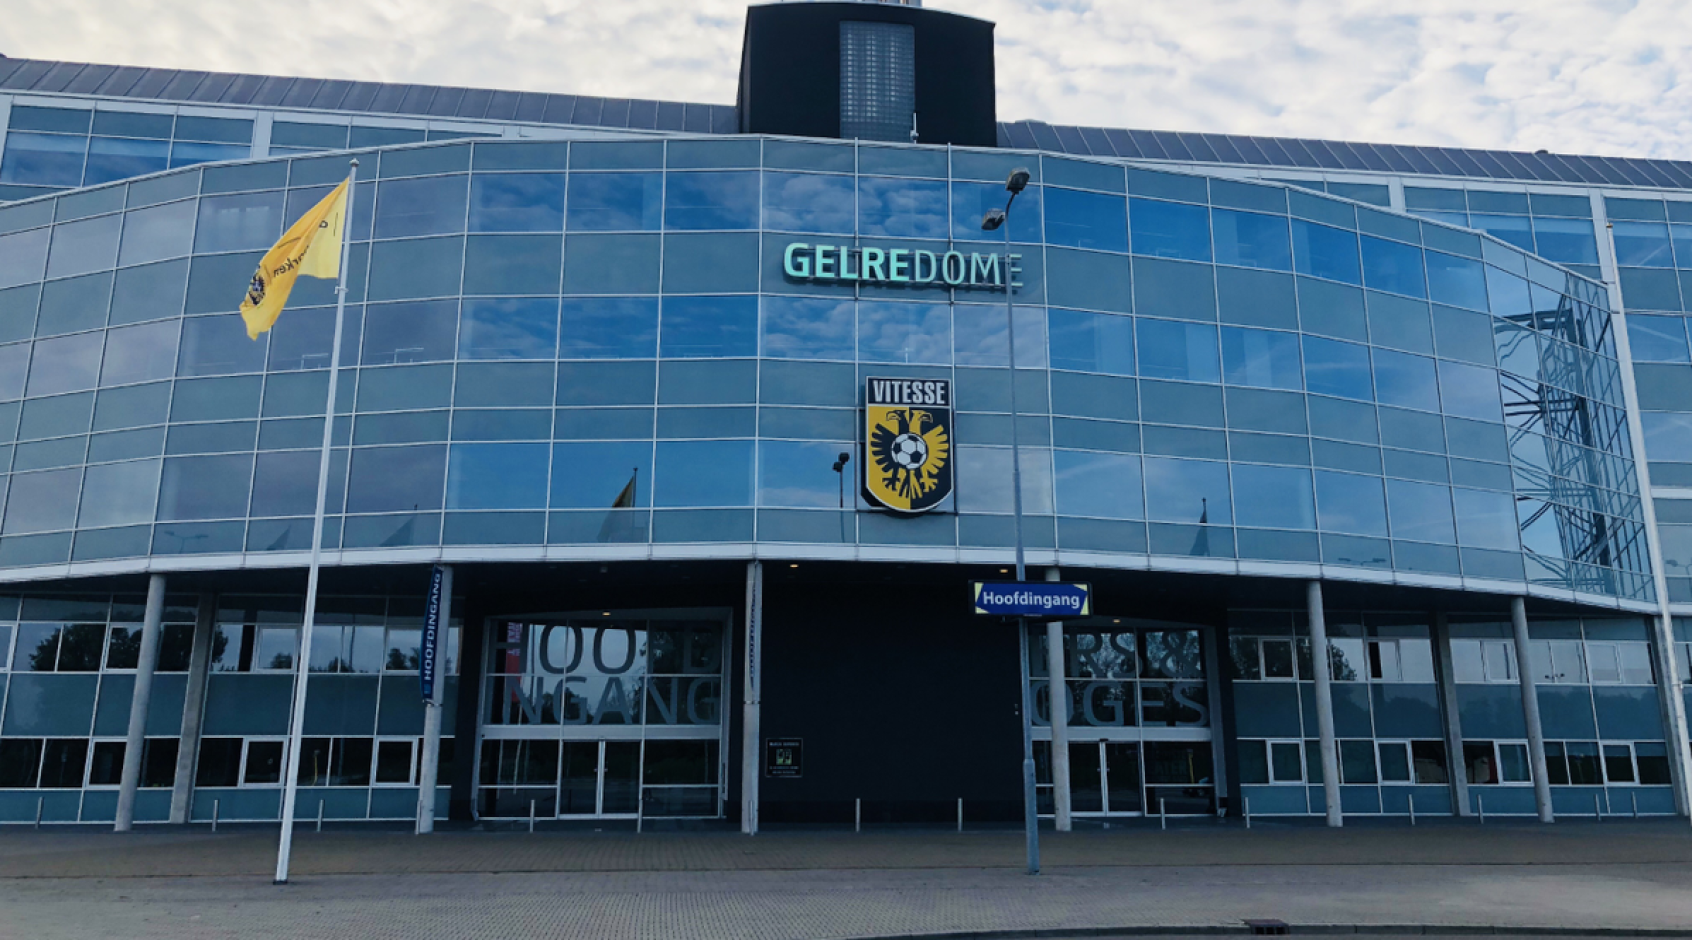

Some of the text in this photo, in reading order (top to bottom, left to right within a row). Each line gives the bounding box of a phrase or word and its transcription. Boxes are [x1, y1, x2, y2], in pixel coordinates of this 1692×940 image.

[783, 242, 1024, 287] GELREDOME
[873, 380, 946, 404] VITESSE
[983, 591, 1080, 609] Hoofdingang
[423, 573, 441, 681] HOOFDINGANG
